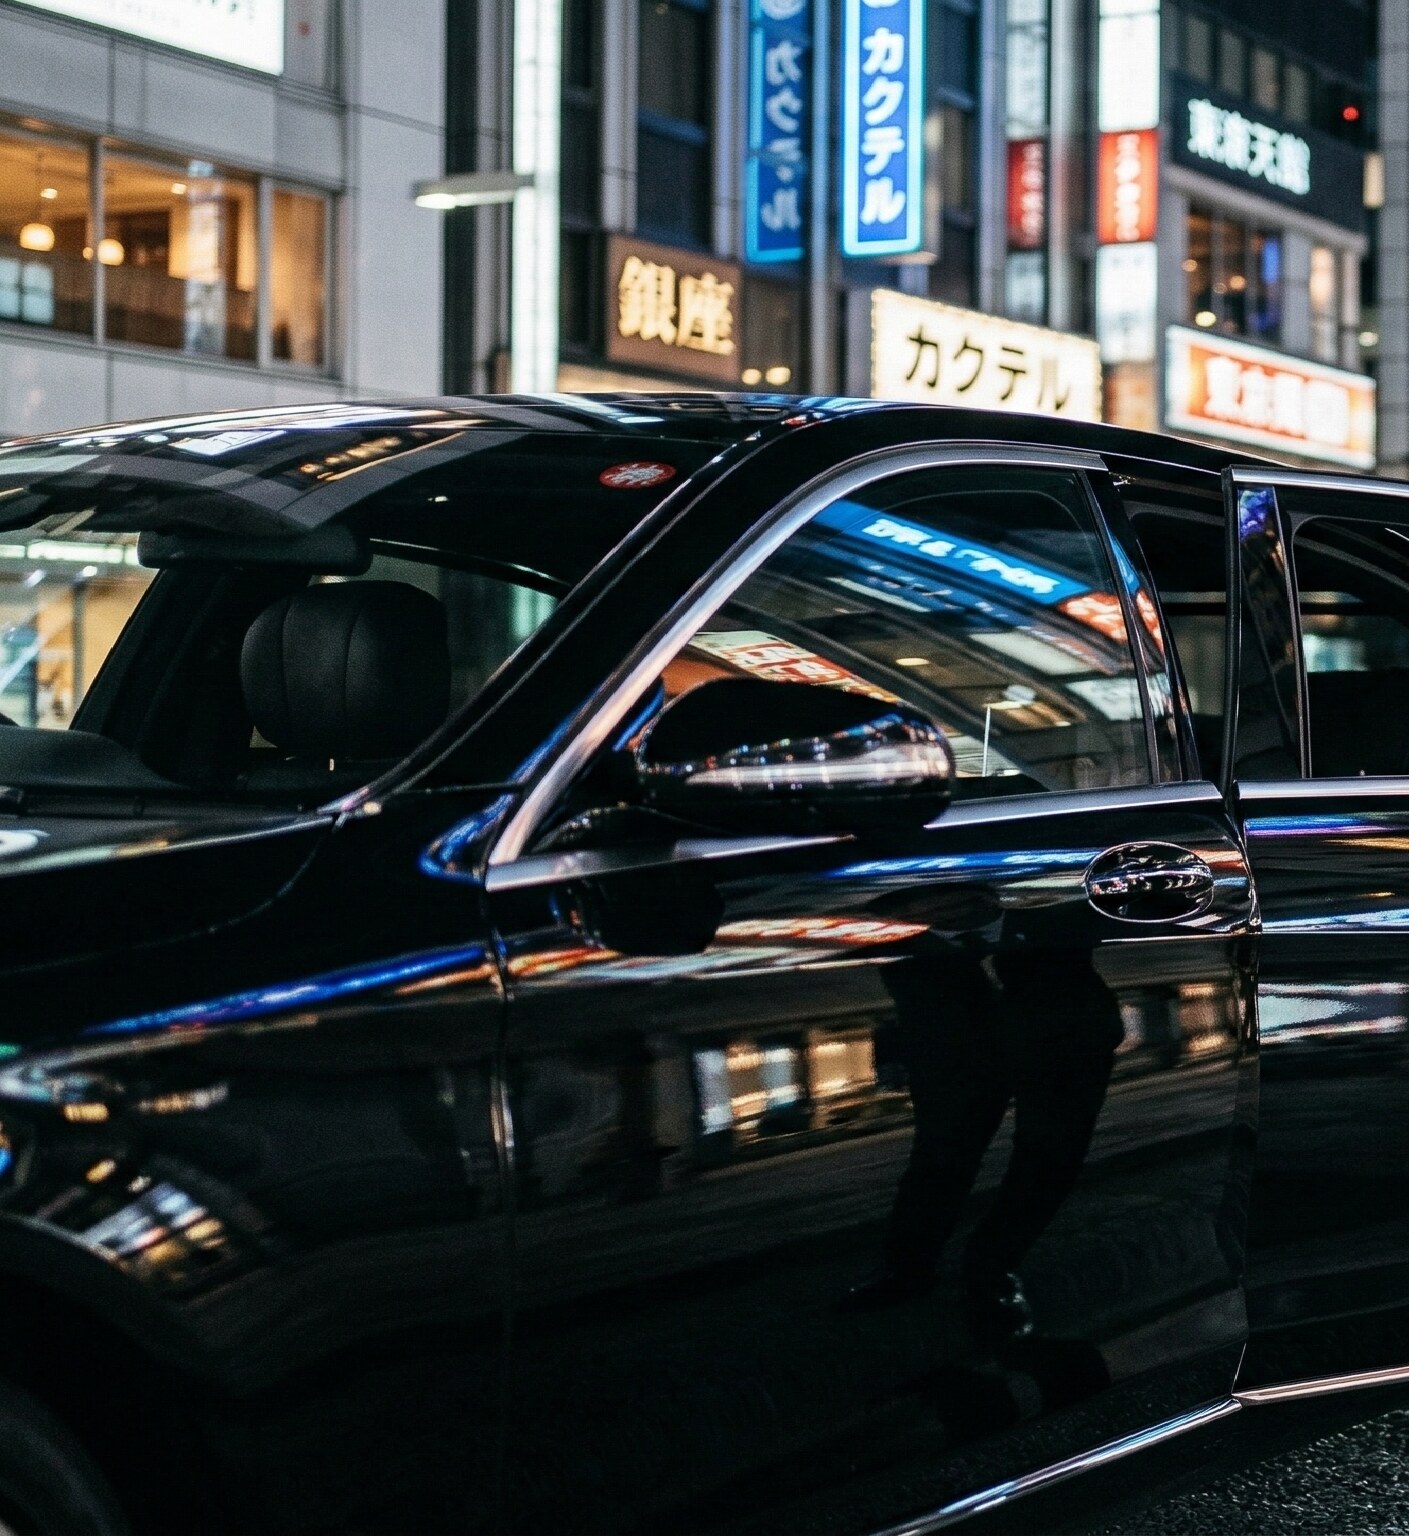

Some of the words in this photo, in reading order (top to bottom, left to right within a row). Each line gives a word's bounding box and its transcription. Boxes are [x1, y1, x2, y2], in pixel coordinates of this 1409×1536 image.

[861, 27, 906, 226] カクテル
[618, 256, 736, 356] 銀座
[907, 324, 1073, 410] カクテル
